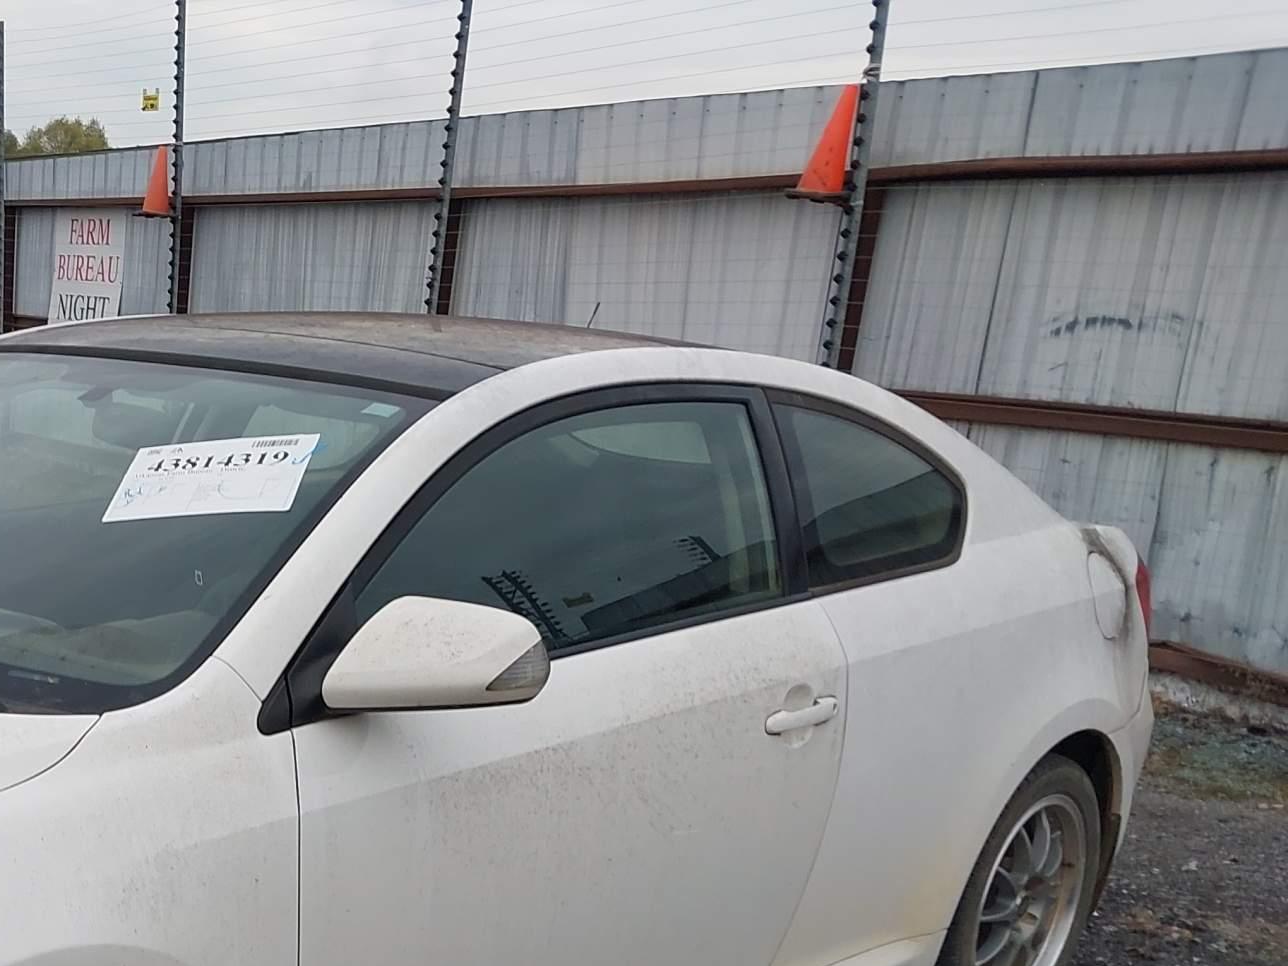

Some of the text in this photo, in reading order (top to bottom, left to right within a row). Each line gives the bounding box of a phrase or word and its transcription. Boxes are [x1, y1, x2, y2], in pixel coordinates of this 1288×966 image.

[69, 218, 111, 246] FARM
[57, 254, 120, 283] BUREAU
[56, 293, 110, 321] NIGHT
[147, 450, 290, 473] 43814319
